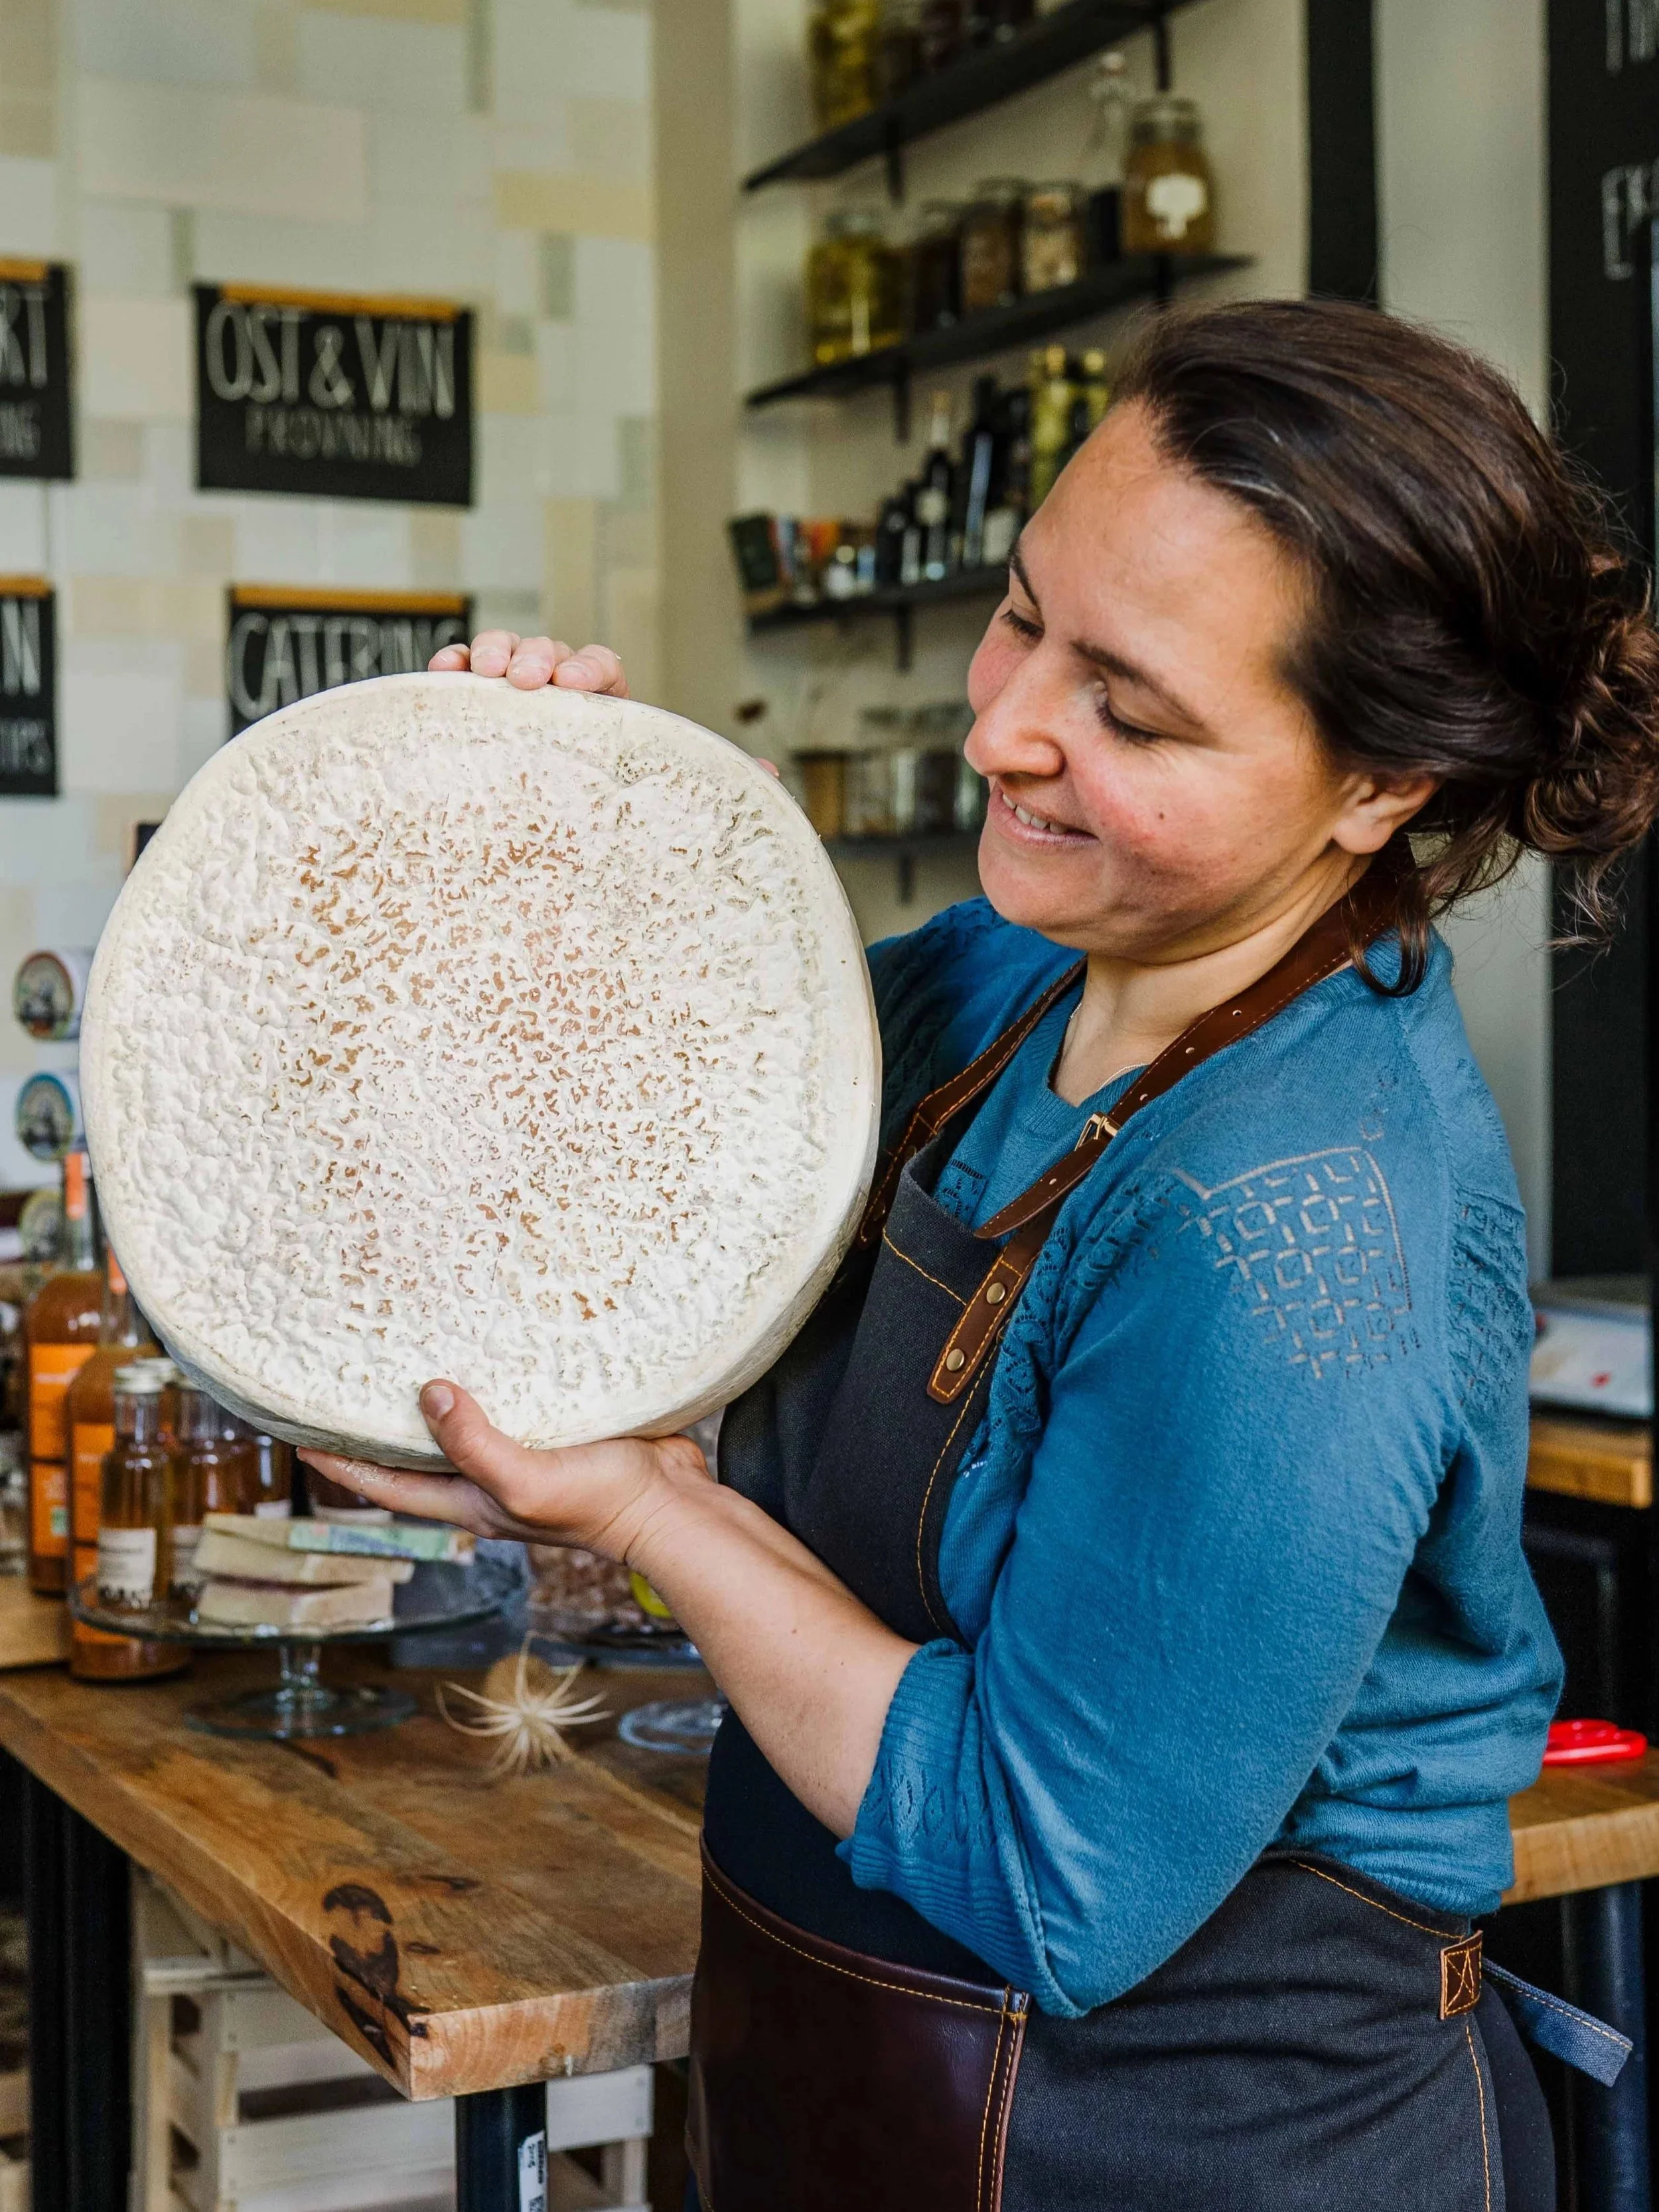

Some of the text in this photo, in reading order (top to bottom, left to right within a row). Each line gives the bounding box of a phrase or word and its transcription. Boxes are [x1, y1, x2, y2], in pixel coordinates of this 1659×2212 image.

[206, 299, 456, 420] OST & VIN
